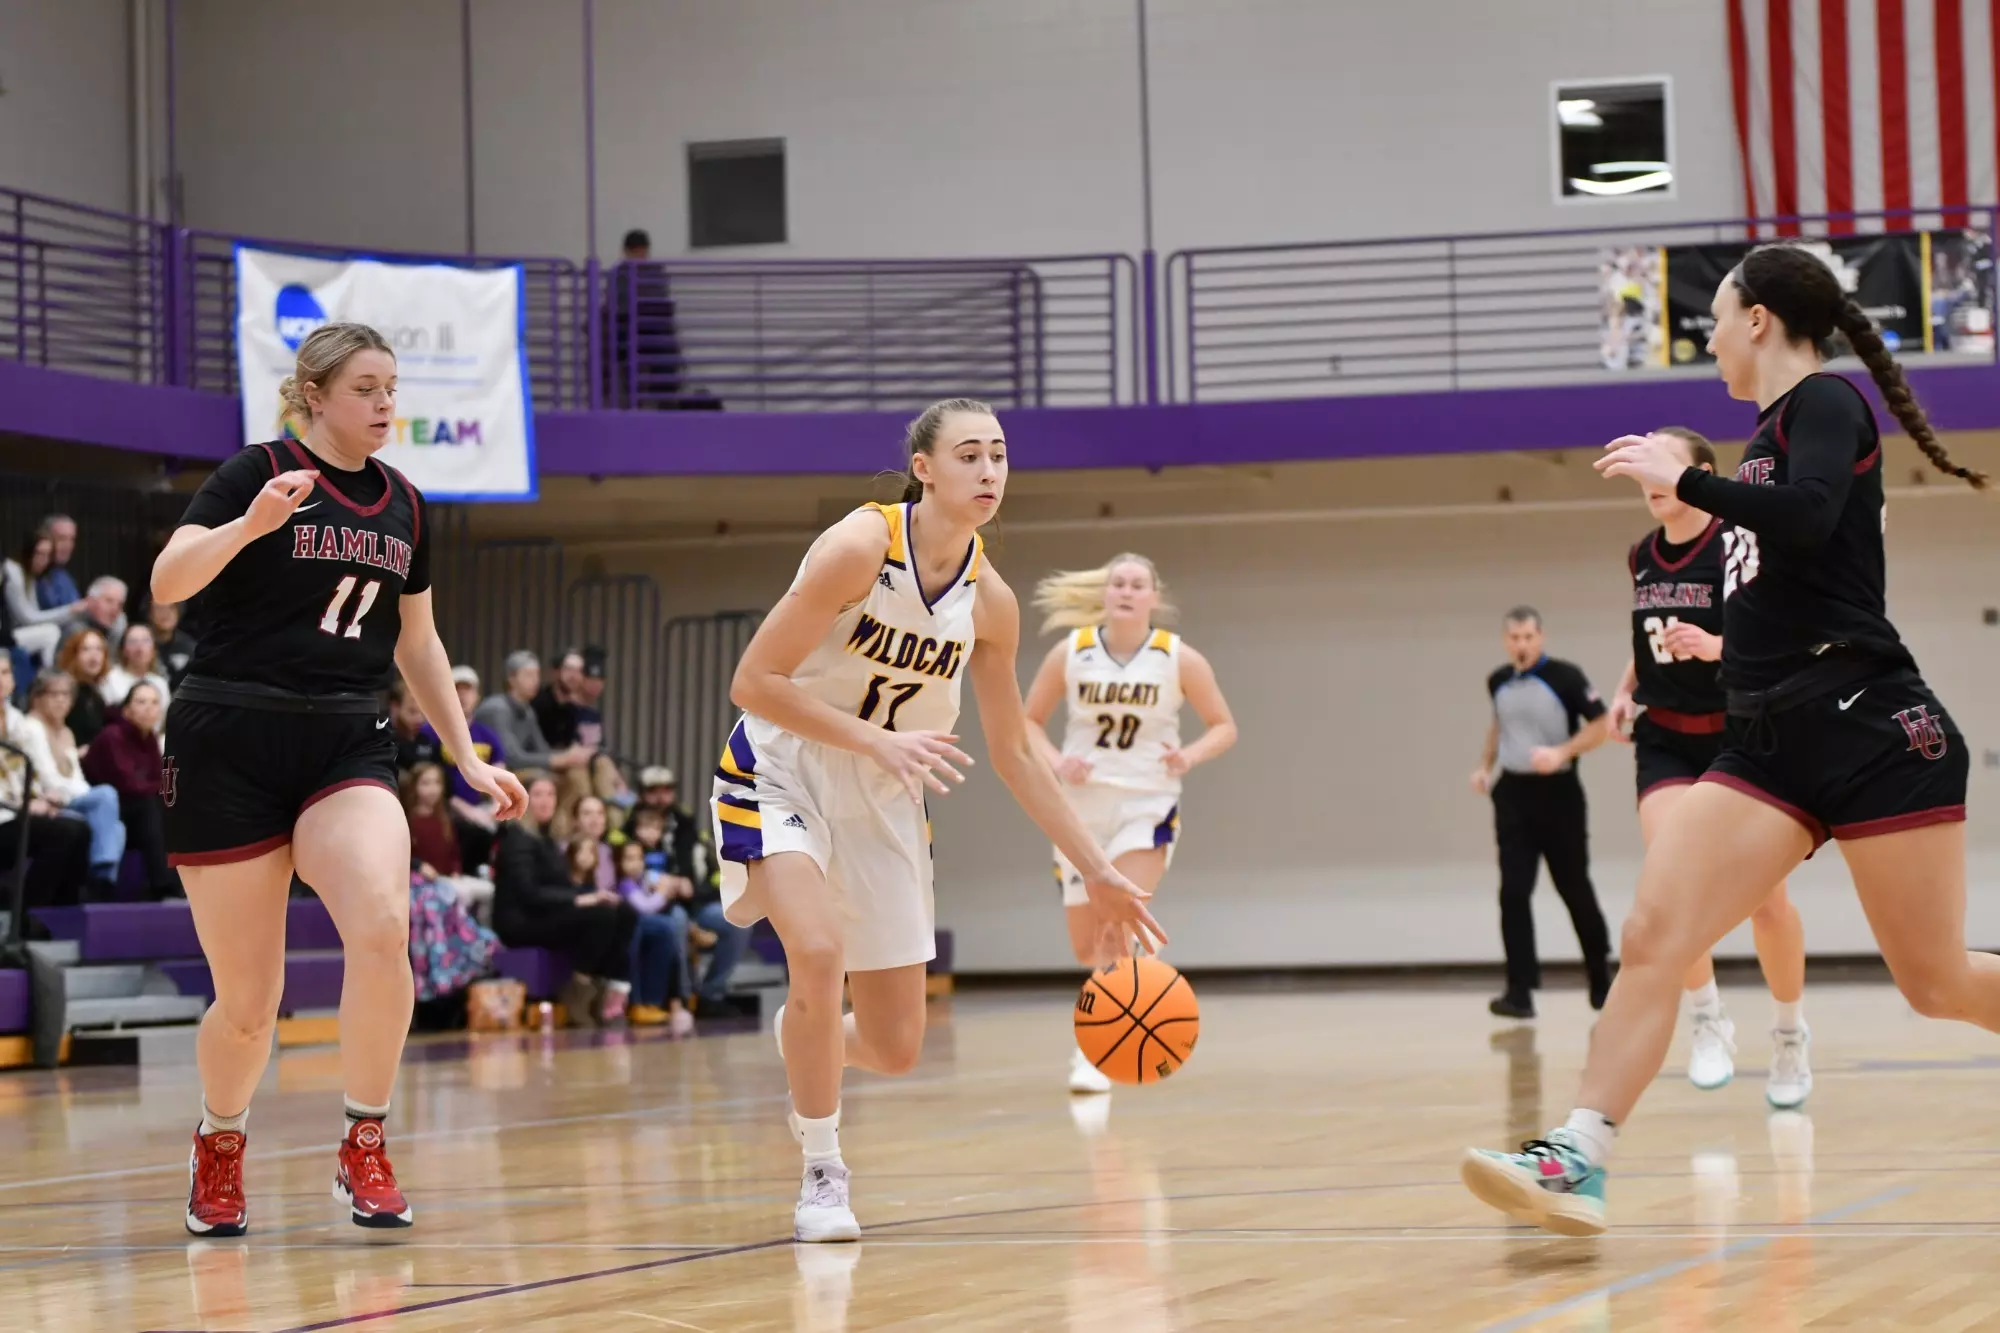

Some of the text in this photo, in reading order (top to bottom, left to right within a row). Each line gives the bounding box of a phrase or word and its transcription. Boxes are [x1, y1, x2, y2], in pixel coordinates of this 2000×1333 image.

[393, 416, 484, 446] TEAM
[293, 525, 412, 580] HAMLINE
[319, 573, 382, 641] 11
[845, 612, 966, 680] WILDCAT
[1096, 713, 1141, 750] 20
